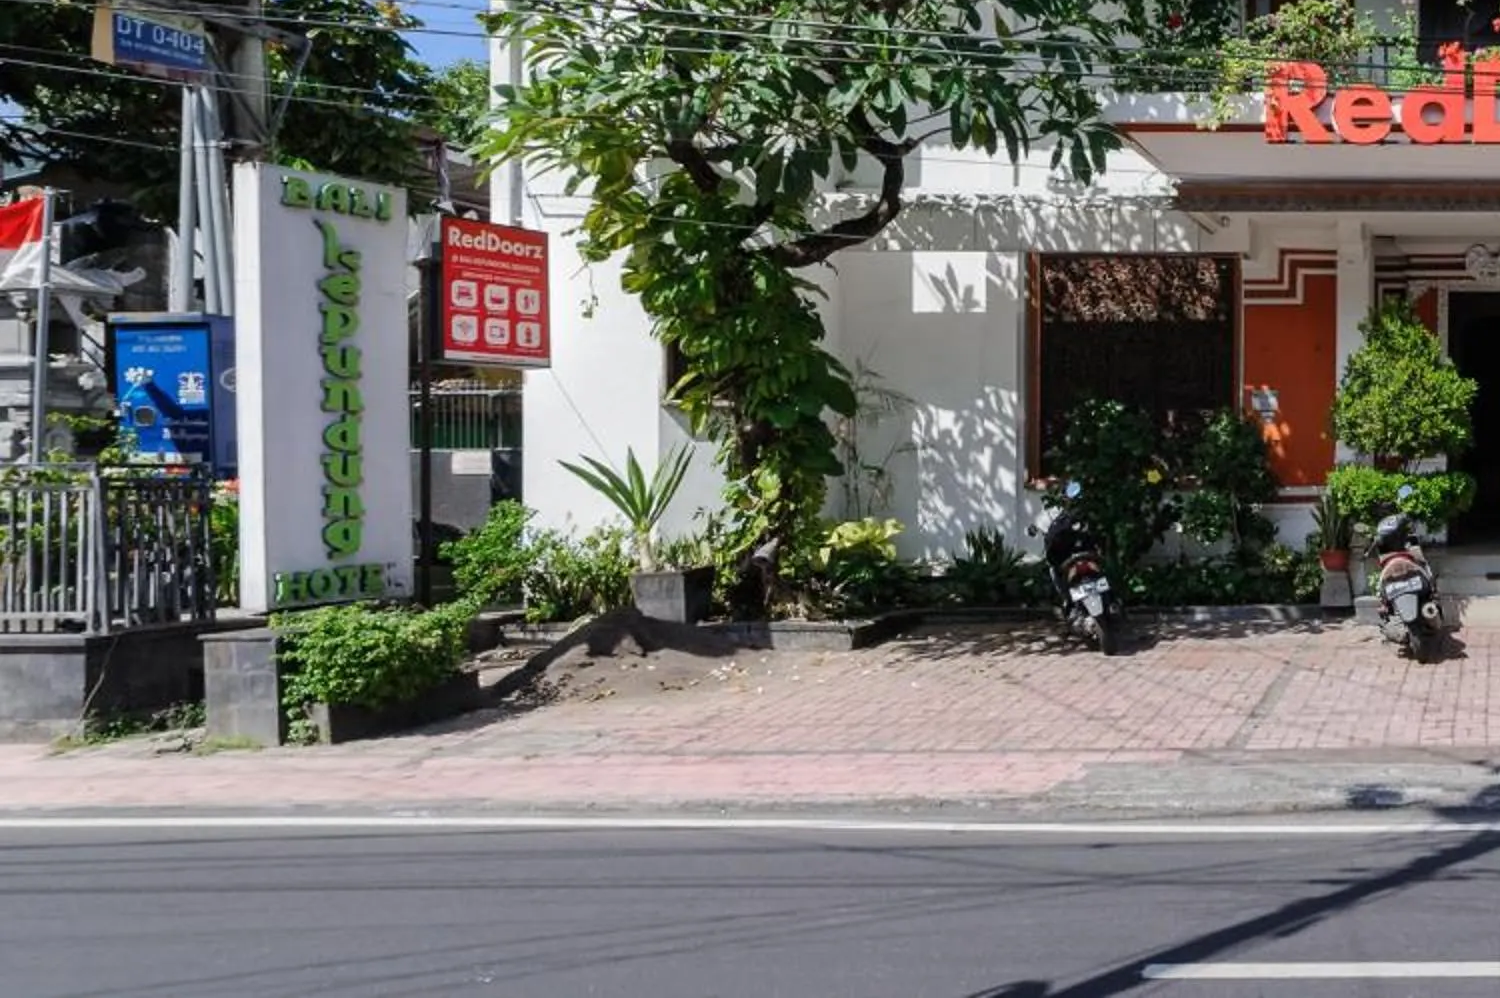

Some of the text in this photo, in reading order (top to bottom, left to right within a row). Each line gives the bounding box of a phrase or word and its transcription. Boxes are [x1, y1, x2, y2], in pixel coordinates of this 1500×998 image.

[117, 15, 145, 39] DT
[152, 25, 205, 54] 0404
[281, 175, 393, 221] BALI
[448, 226, 544, 259] RedDoorz
